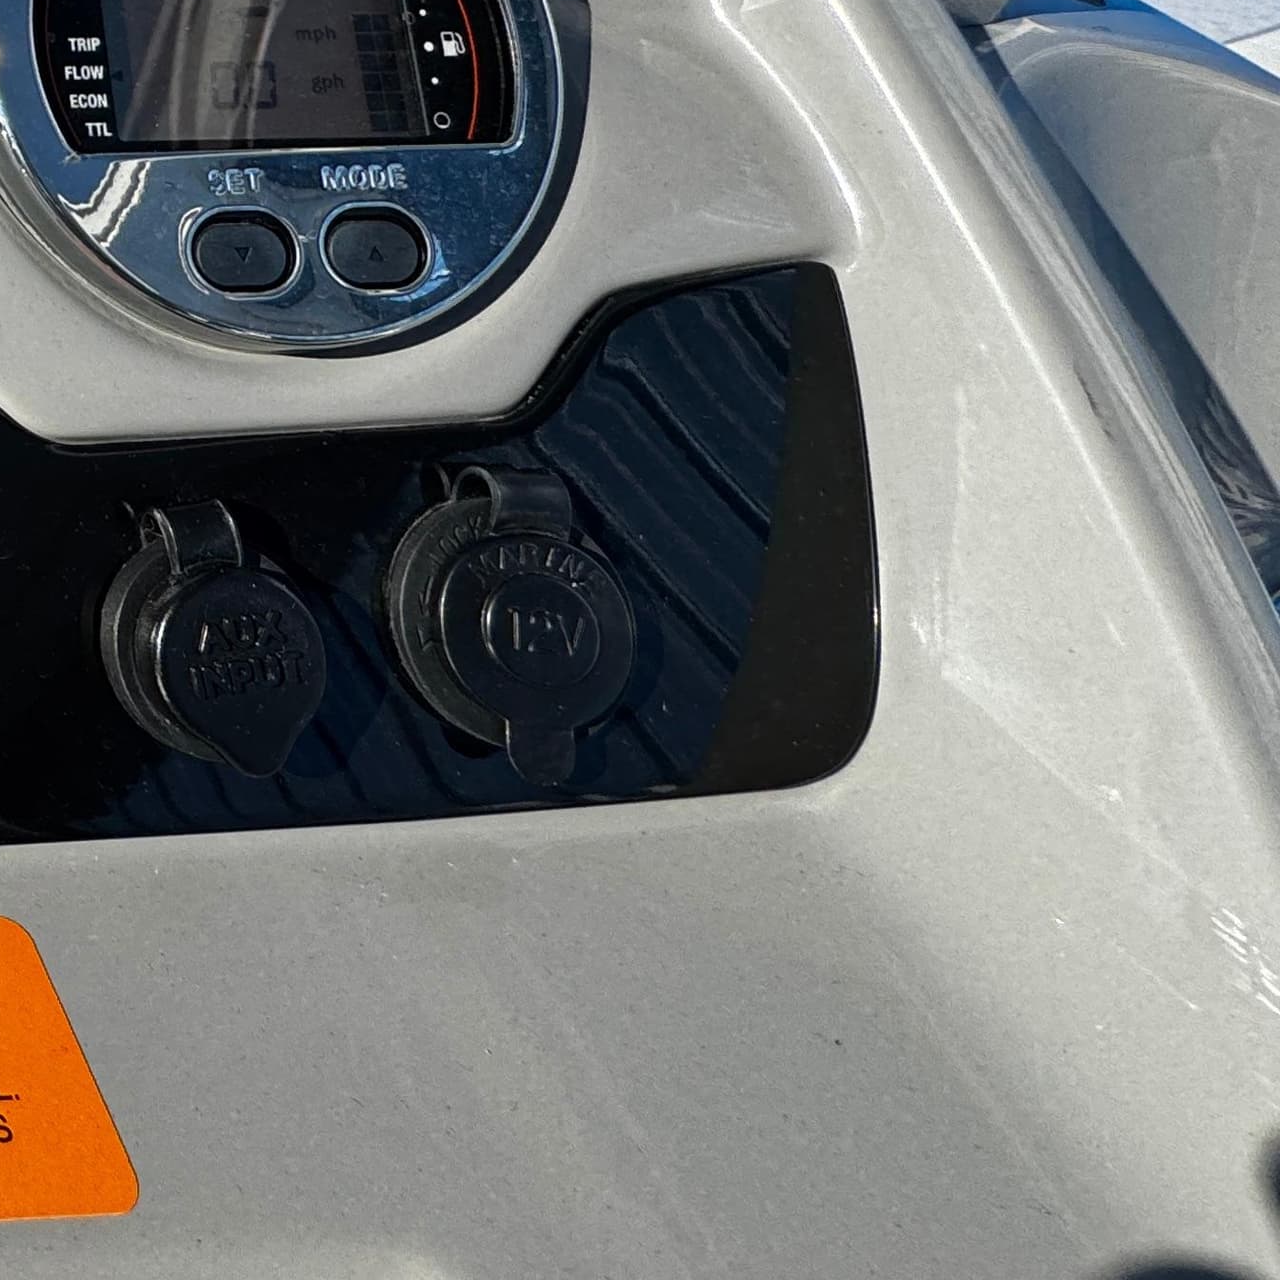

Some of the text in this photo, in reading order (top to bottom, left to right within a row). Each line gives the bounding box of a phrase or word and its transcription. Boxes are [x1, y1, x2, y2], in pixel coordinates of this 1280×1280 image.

[295, 25, 337, 43] mph
[68, 37, 101, 53] TRIP
[64, 65, 105, 82] FLOW
[311, 73, 345, 94] gph
[69, 94, 109, 110] ECON
[85, 122, 113, 138] TTL
[207, 167, 265, 196] SET
[320, 163, 409, 192] MODE
[197, 608, 288, 654] AUX
[505, 606, 587, 658] 12V
[187, 649, 308, 701] INPUT
